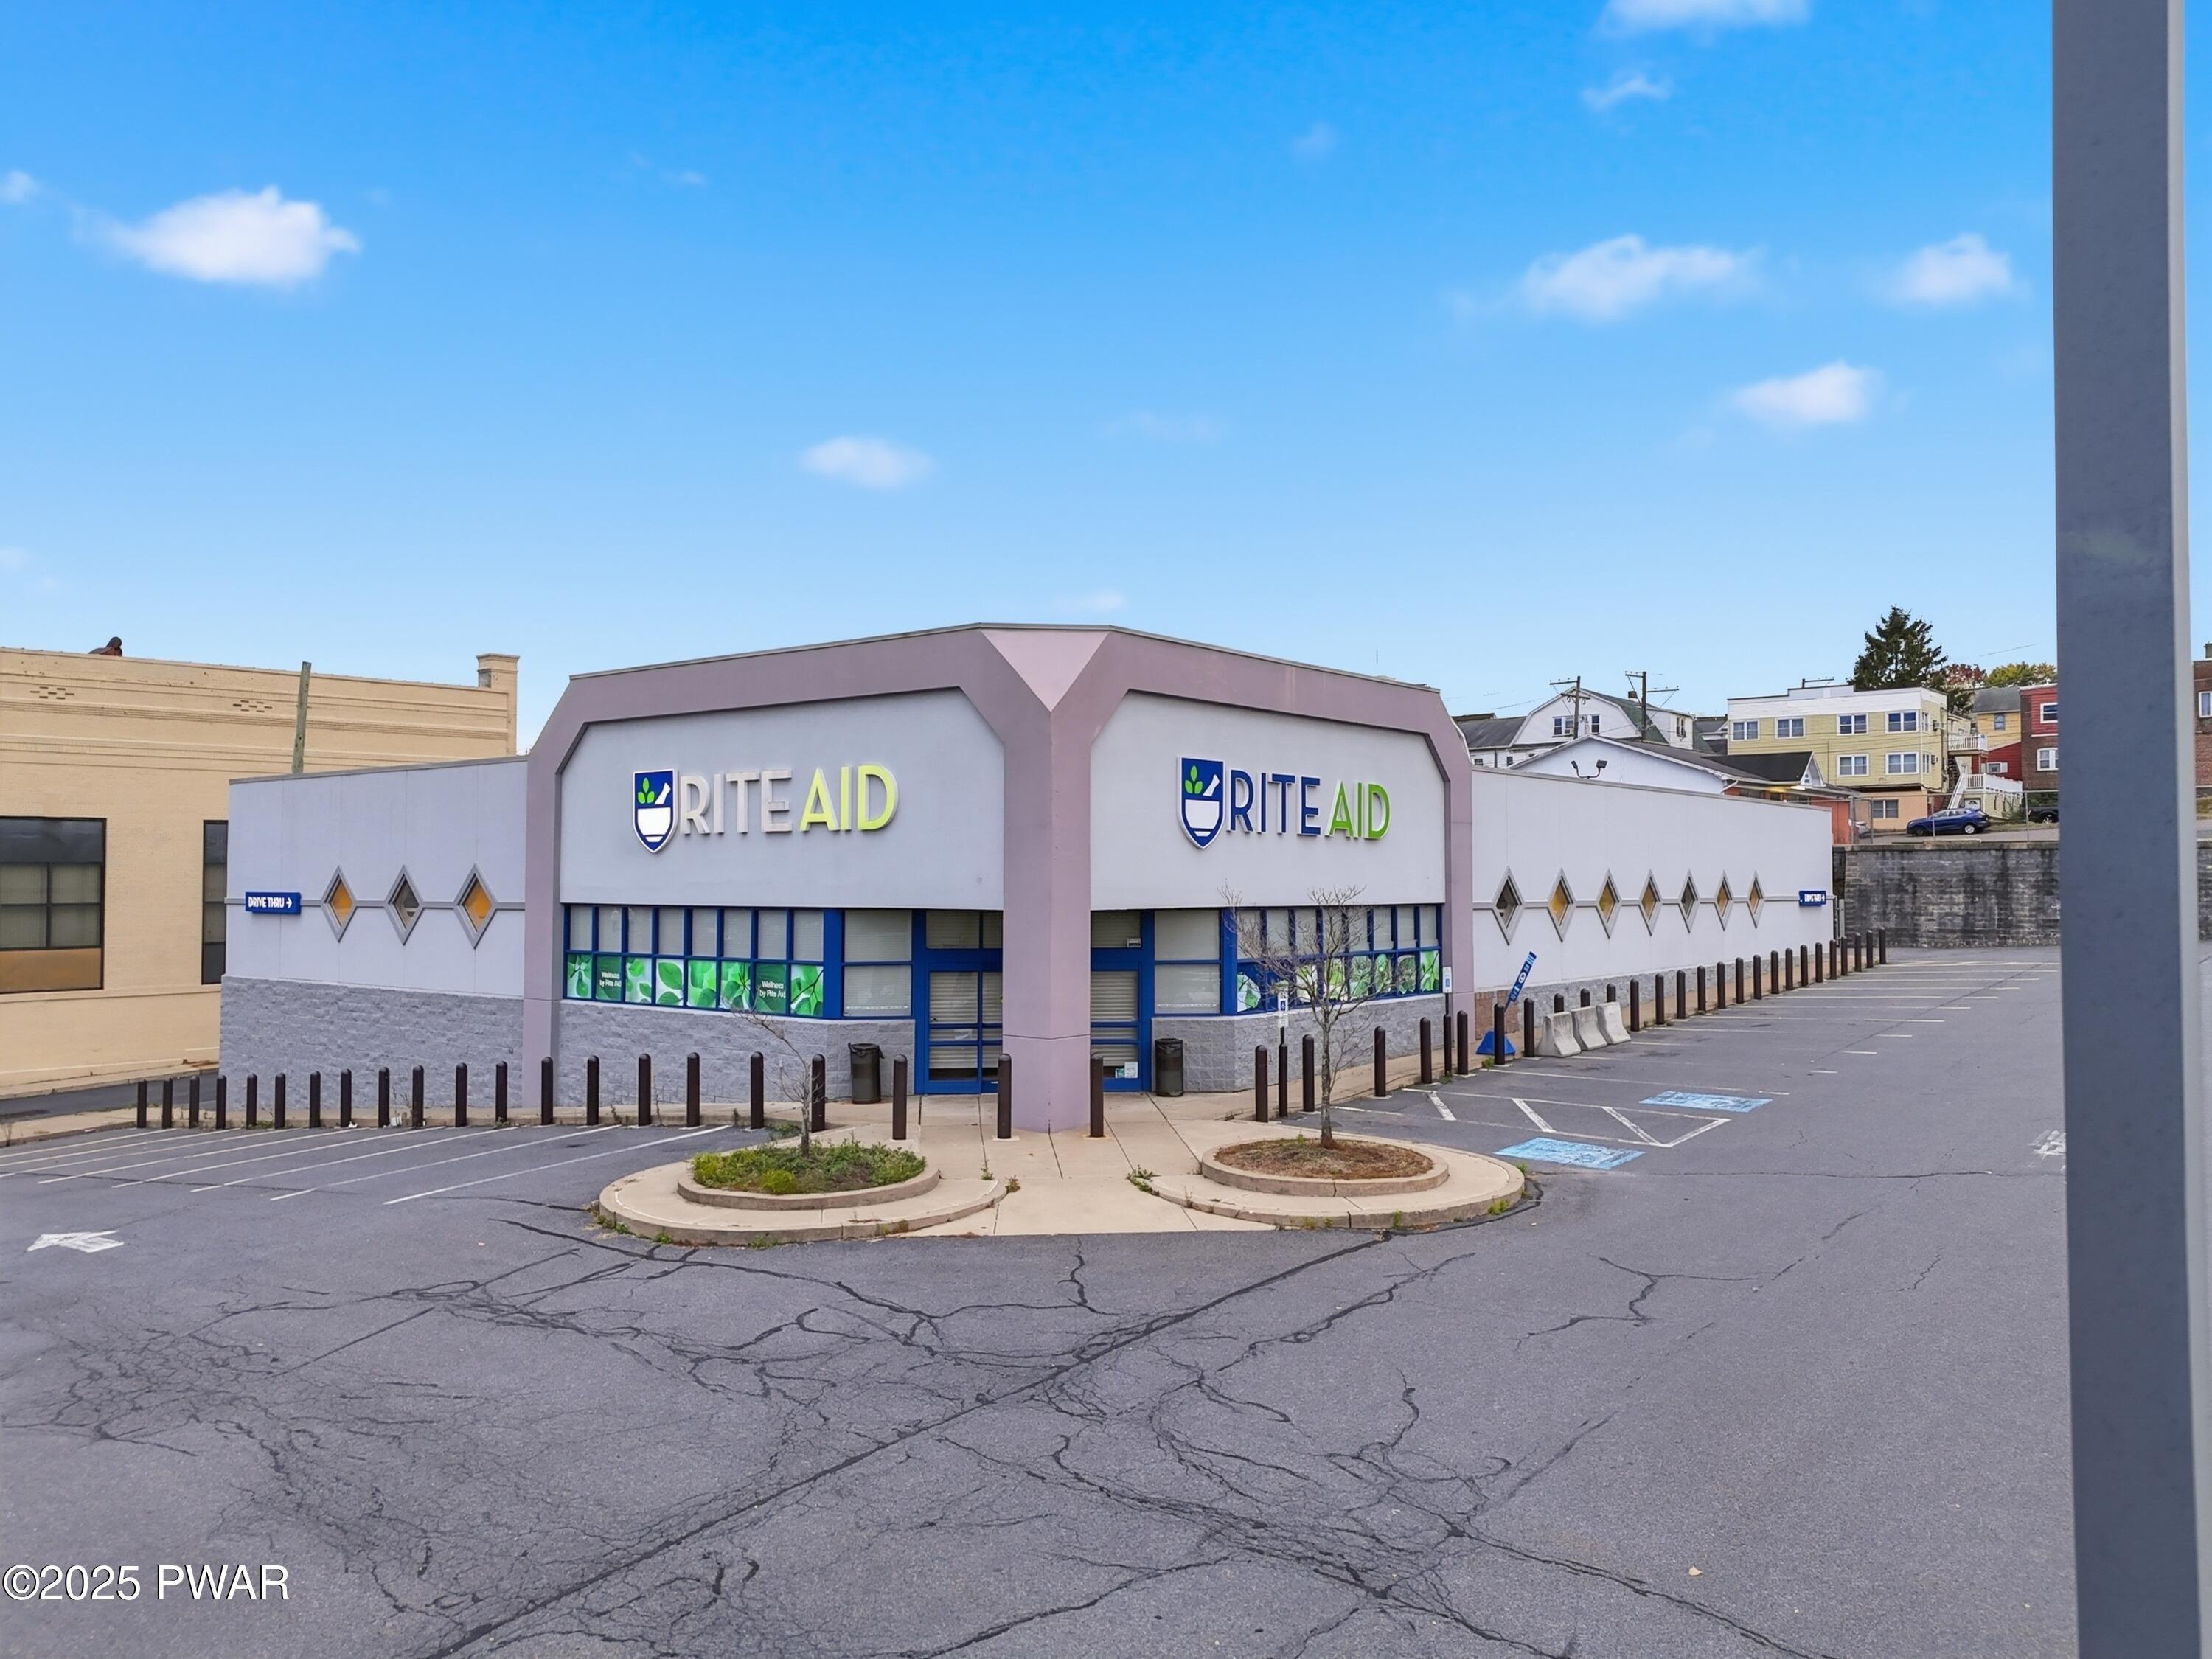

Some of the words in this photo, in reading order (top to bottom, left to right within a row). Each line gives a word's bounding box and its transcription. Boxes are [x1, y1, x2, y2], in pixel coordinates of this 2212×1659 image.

[680, 769, 793, 835] RITE
[799, 764, 900, 832] AID
[1226, 768, 1321, 837] RITE
[1324, 779, 1392, 840] AID
[248, 896, 267, 908] DRIVE
[268, 897, 285, 908] THRU
